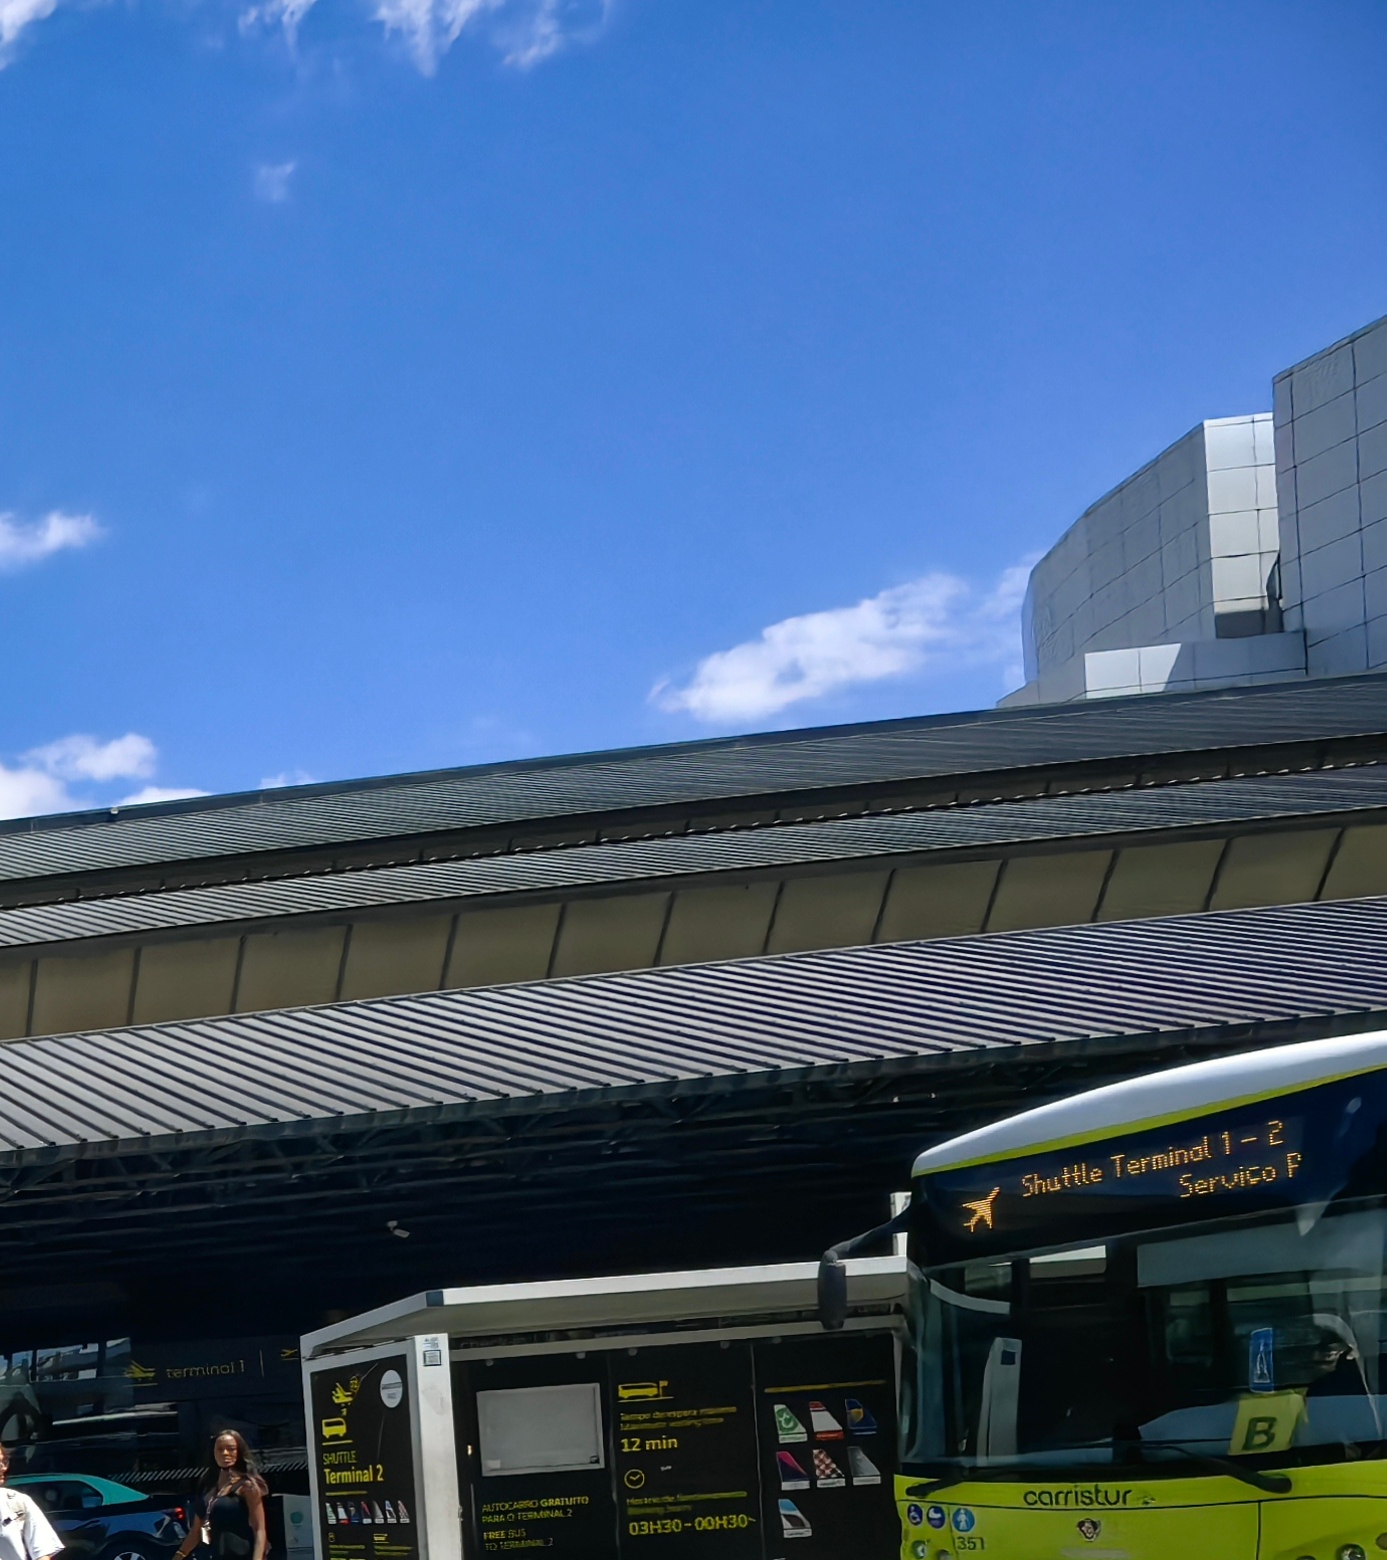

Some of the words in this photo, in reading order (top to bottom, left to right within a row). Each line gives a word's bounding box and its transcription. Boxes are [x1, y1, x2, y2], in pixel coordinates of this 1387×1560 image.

[1022, 1163, 1103, 1197] Shuttle
[1110, 1136, 1212, 1178] Terminal
[1221, 1131, 1230, 1155] 1
[1267, 1120, 1283, 1145] 2
[166, 1361, 234, 1379] terminal
[239, 1359, 245, 1373] 1
[1242, 1416, 1276, 1451] B
[620, 1437, 642, 1453] 12
[645, 1434, 678, 1451] min
[323, 1450, 357, 1465] SHUTTLE
[324, 1464, 374, 1485] Terminal
[376, 1464, 385, 1482] 2
[540, 1496, 589, 1507] GRATUITO
[1023, 1484, 1132, 1507] carristur
[483, 1530, 505, 1540] FREE
[629, 1518, 682, 1536] 03H30
[957, 1536, 984, 1551] 351
